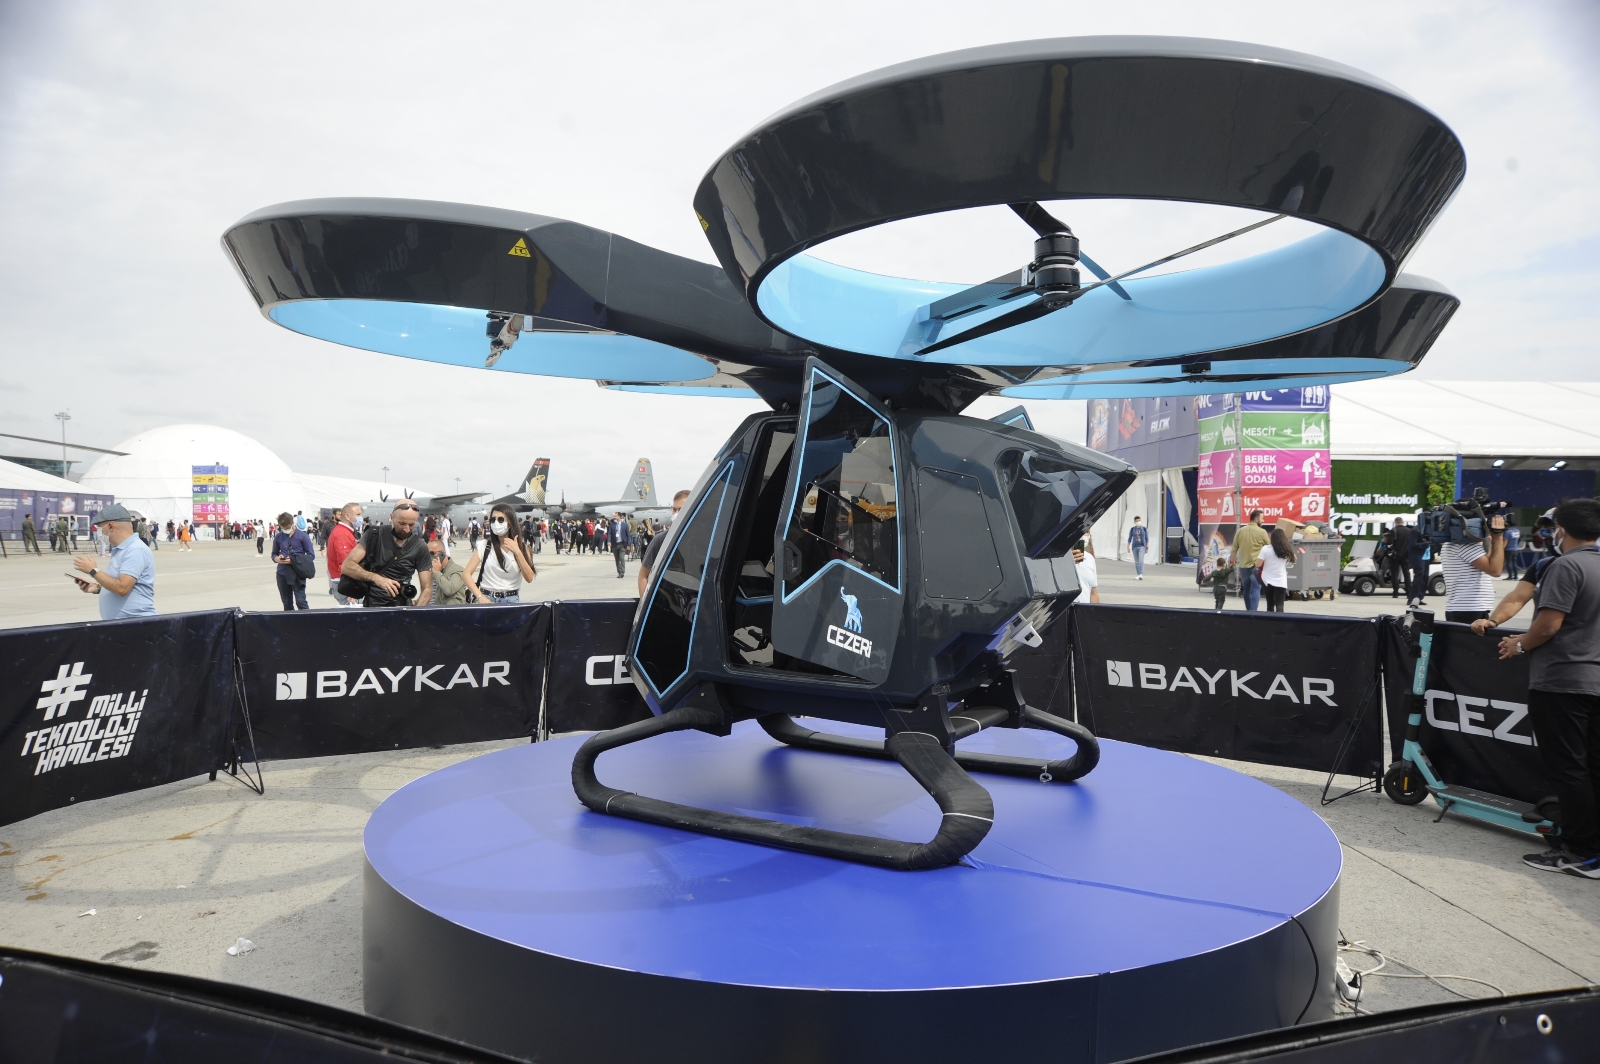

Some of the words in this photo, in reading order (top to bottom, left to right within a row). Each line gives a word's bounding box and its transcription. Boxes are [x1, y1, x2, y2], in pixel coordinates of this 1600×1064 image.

[1243, 426, 1276, 436] MESCİT
[1244, 455, 1277, 464] BEBEK
[1244, 465, 1277, 474] BAKIM
[1245, 474, 1276, 484] ODASI
[1244, 495, 1260, 506] İLK
[1336, 493, 1371, 505] Verimli
[1373, 493, 1418, 507] Teknoloji
[316, 660, 511, 699] BAYKAR
[1138, 662, 1339, 707] BAYKAR
